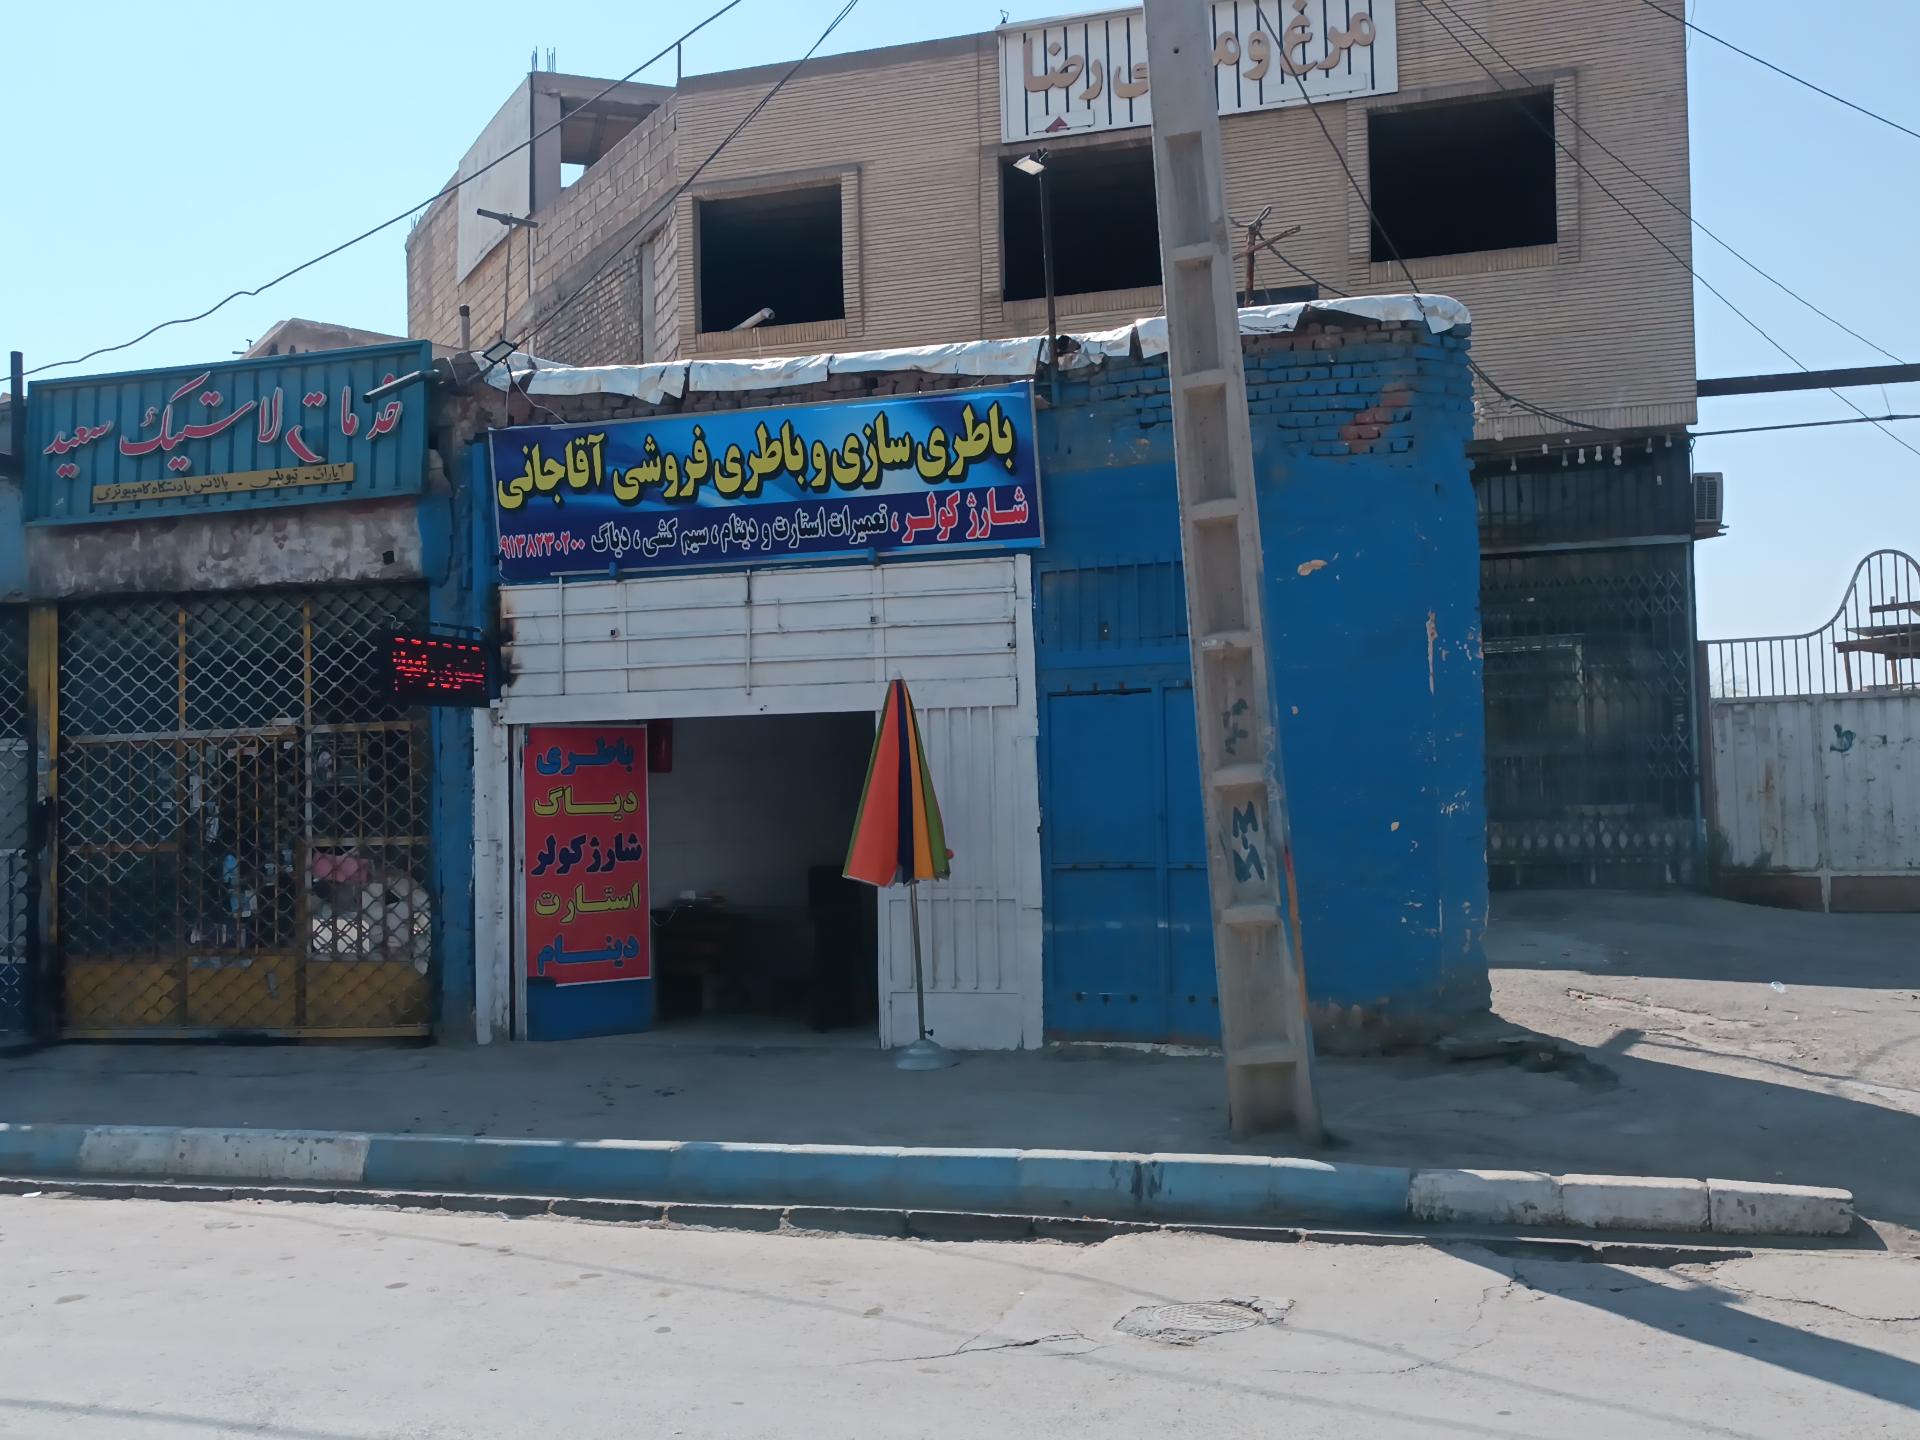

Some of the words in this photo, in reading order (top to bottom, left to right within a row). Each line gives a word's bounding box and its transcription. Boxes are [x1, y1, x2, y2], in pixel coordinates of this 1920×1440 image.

[1242, 30, 1271, 80] و
[1280, 0, 1376, 77] مرغ
[1023, 36, 1103, 101] رضا
[119, 370, 284, 473] لاستیک
[285, 373, 404, 464] خدمات
[917, 402, 1014, 478] باطری
[43, 419, 114, 479] سعید
[498, 432, 605, 509] آقاجانی
[613, 426, 709, 500] فروشی
[714, 420, 805, 493] باطری
[811, 440, 828, 487] و
[832, 411, 911, 485] سازی
[760, 522, 772, 550] و
[772, 507, 827, 549] استارت
[827, 503, 889, 545] تعمیرات
[966, 486, 1029, 540] شارژ
[591, 521, 630, 558] دیاگ
[681, 526, 709, 555] سیم
[536, 736, 635, 776] باطری
[533, 785, 639, 820] دیاگ
[531, 834, 588, 877] کولر
[586, 833, 643, 873] شارژ
[534, 881, 641, 924] استارت
[536, 934, 640, 977] دینام
